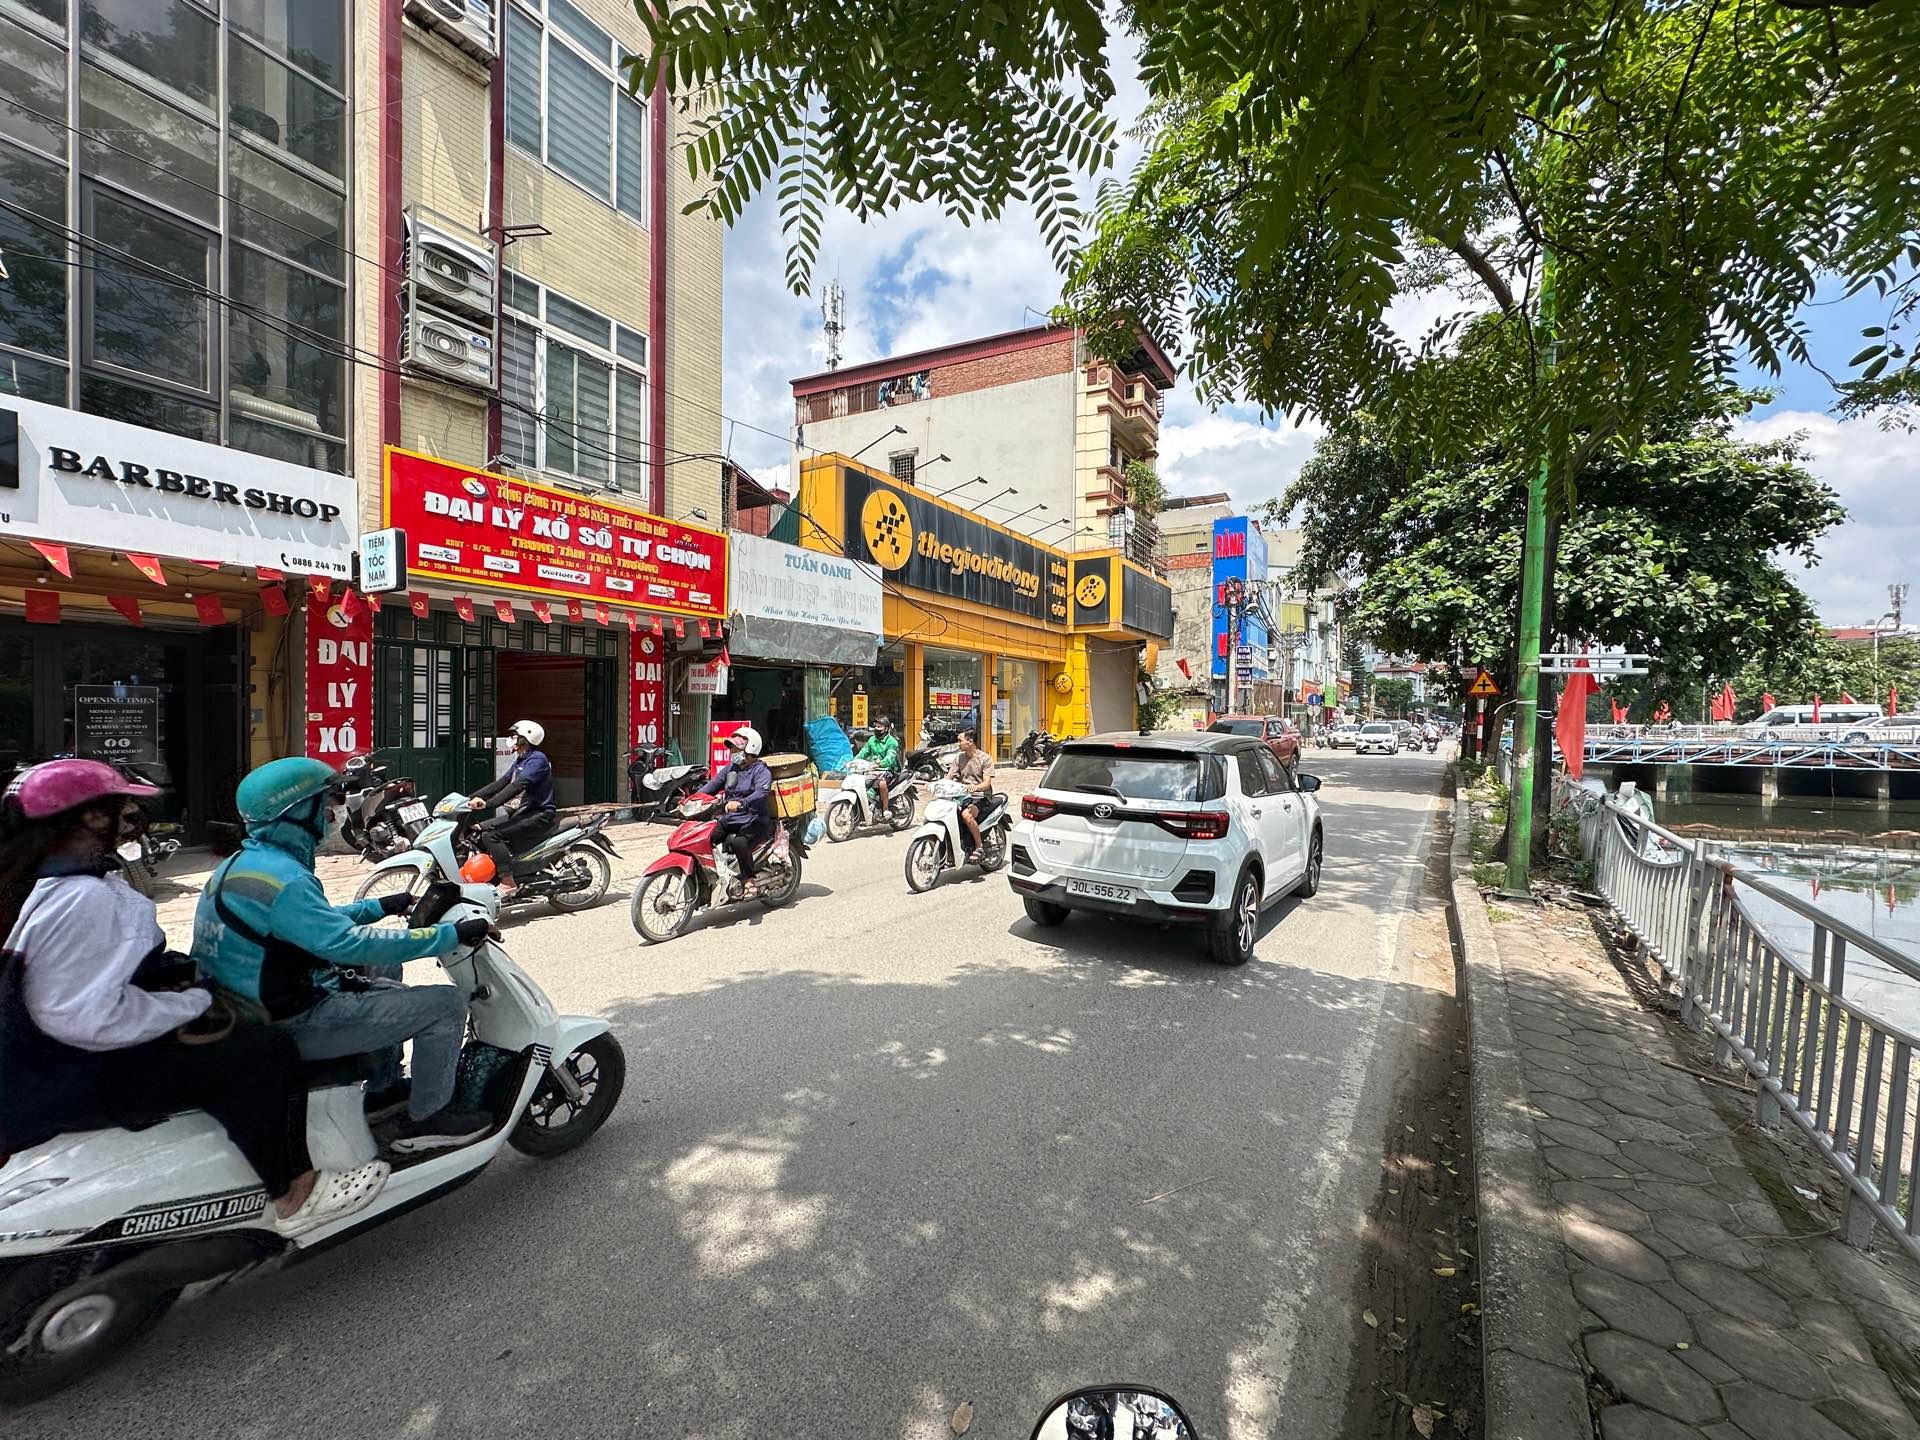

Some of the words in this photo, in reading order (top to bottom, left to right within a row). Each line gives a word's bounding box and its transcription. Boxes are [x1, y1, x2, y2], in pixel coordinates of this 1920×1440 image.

[48, 446, 340, 522] BARBERSHOP
[423, 490, 484, 523] ĐẠI
[492, 507, 524, 530] LÝ
[532, 514, 570, 540] XỔ
[578, 526, 612, 549] SỐ
[620, 536, 652, 560] TỰ
[656, 544, 711, 571] CHỌN
[368, 536, 384, 551] TIỆM
[509, 536, 555, 554] TRUNG
[558, 544, 586, 560] TÂM
[1216, 529, 1246, 558] RĂNG
[292, 557, 312, 567] 0886
[315, 561, 330, 570] 244
[332, 564, 346, 572] 789
[368, 554, 384, 567] TÓC
[784, 553, 818, 573] TUẤN
[821, 562, 852, 580] OANH
[918, 531, 1040, 598] thegioididong
[368, 570, 385, 582] NAM
[542, 569, 574, 578] Vietlott
[1052, 602, 1066, 618] GÓP
[635, 662, 661, 684] ĐẠI
[328, 678, 358, 708] LÝ
[640, 690, 656, 711] LÝ
[670, 703, 680, 712] 154
[319, 718, 356, 752] XỔ
[638, 718, 656, 744] XỔ
[121, 1200, 223, 1236] CHRISTIAN
[225, 1192, 267, 1216] DIOR
